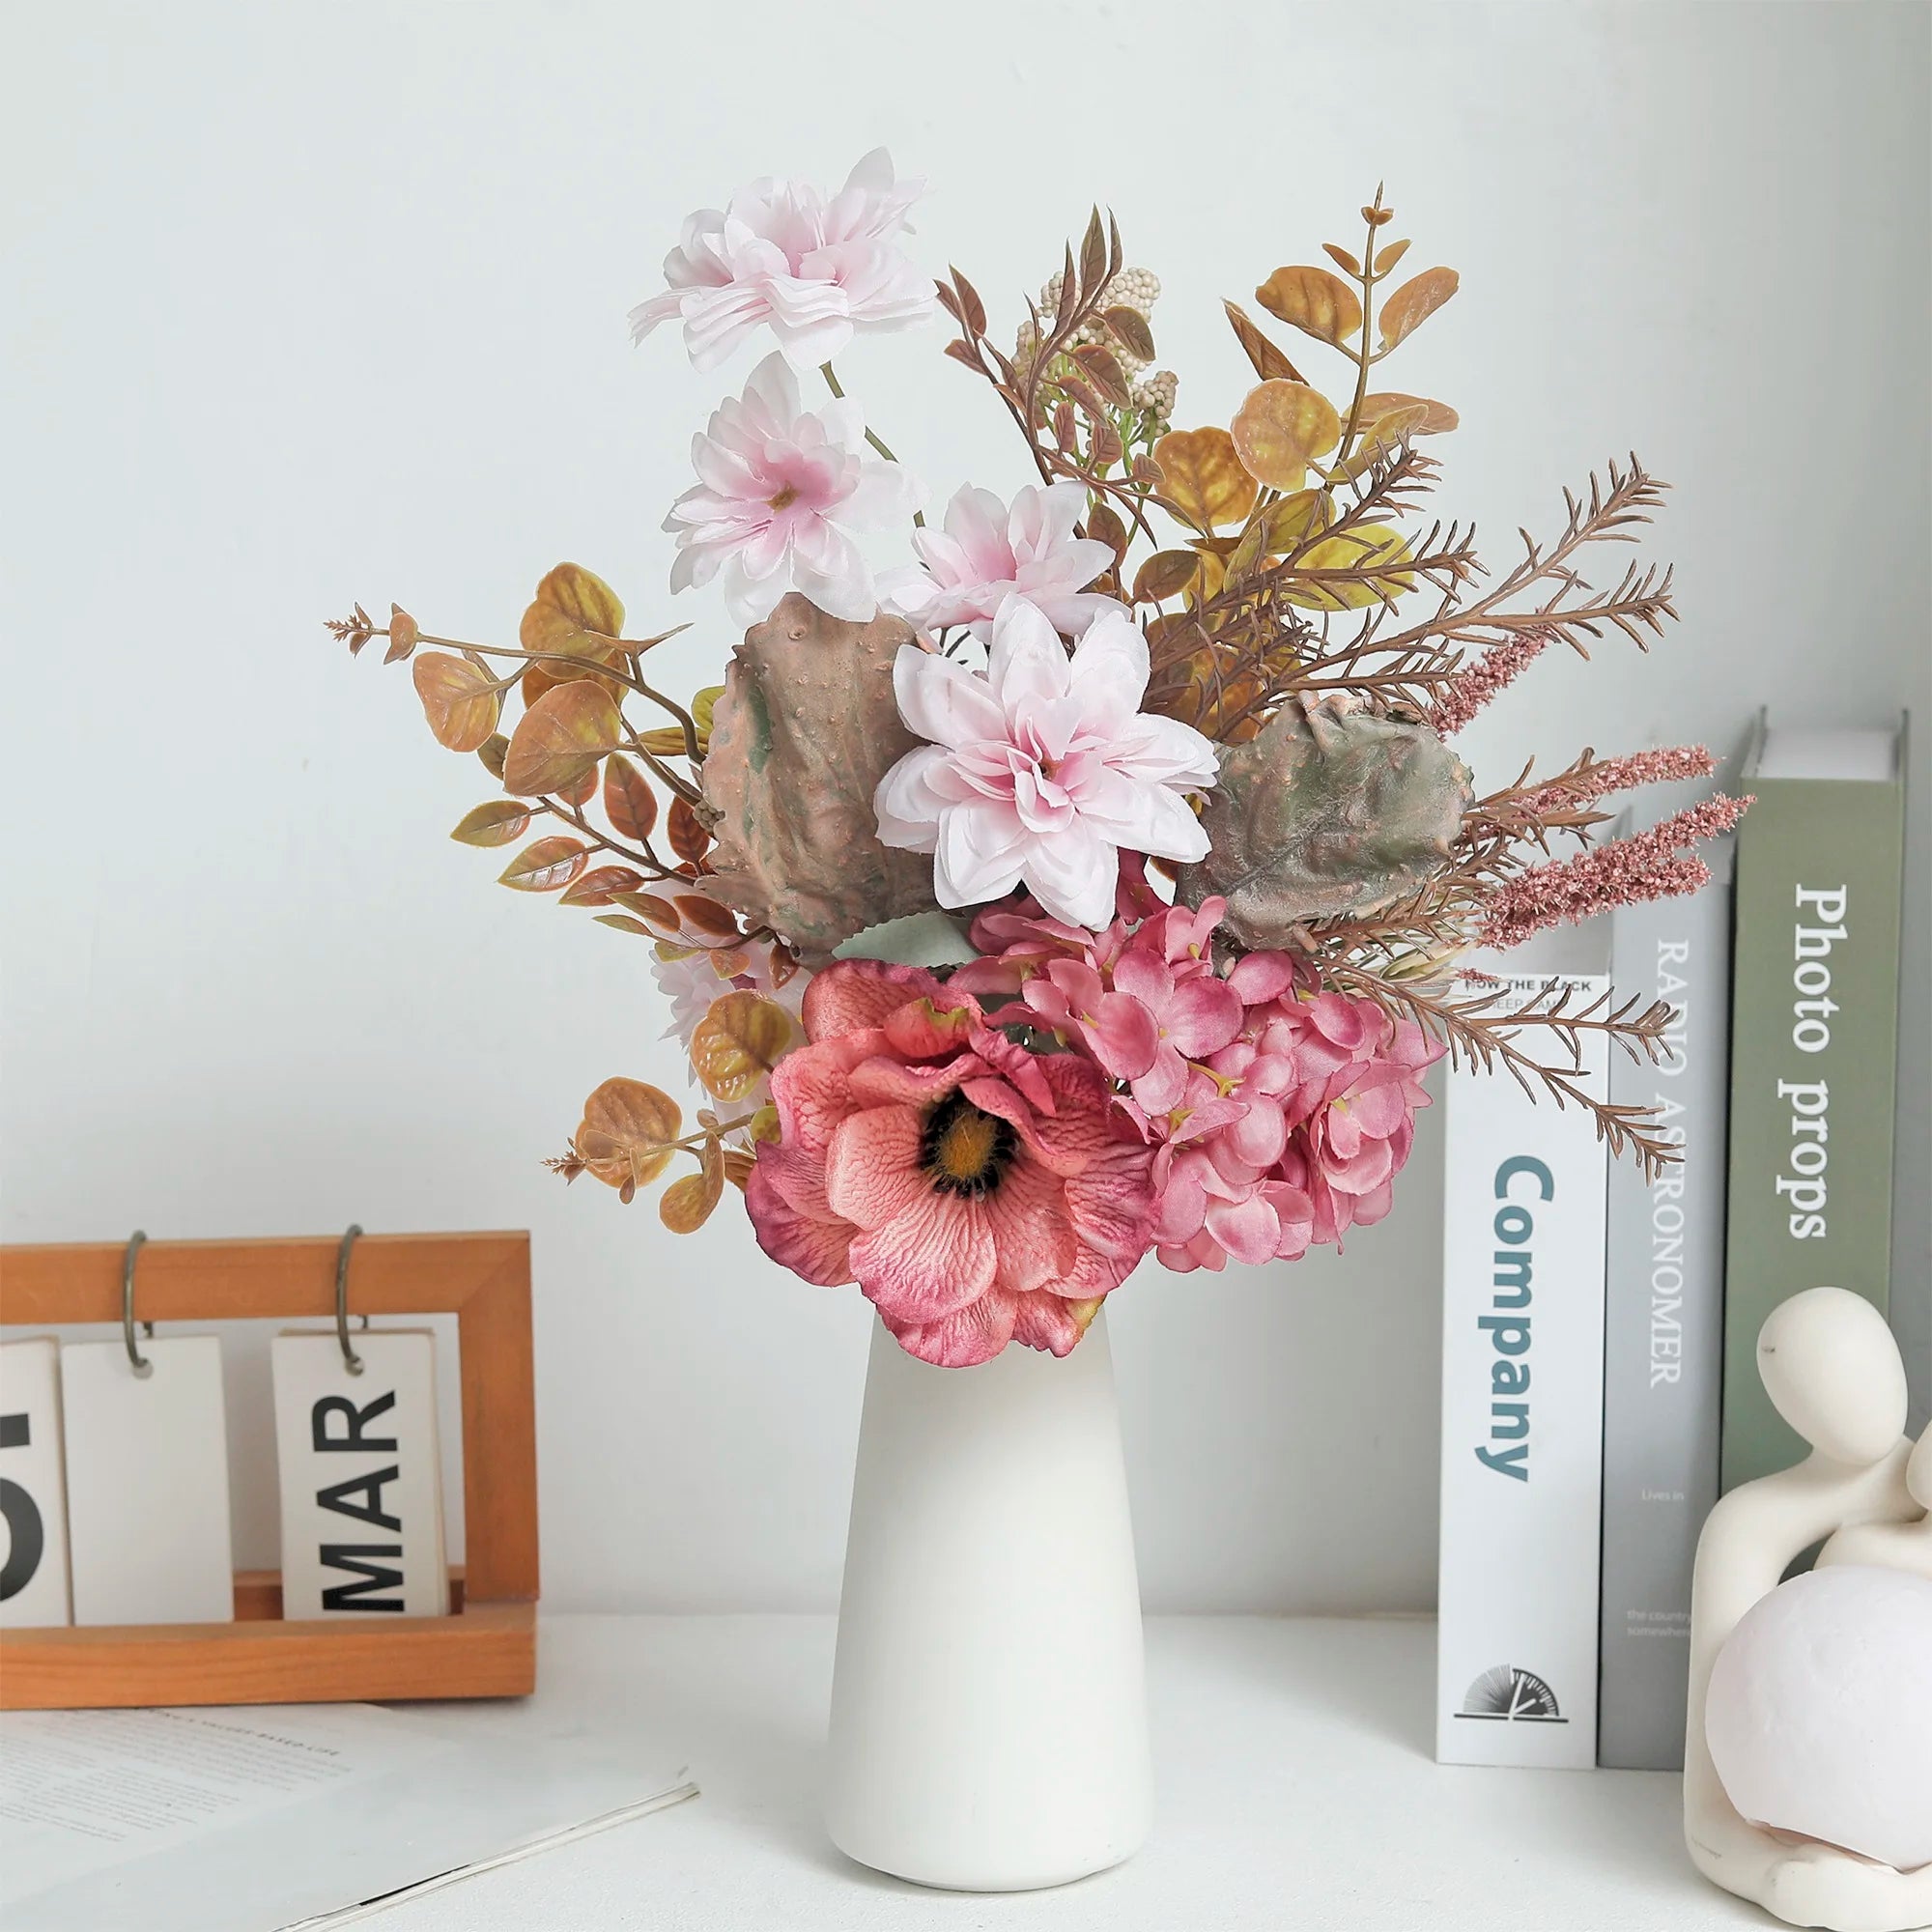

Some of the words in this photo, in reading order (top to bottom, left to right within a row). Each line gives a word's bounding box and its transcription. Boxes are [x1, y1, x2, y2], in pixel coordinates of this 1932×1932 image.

[1507, 980, 1535, 990] THE
[1793, 884, 1847, 1054] Photo
[1776, 1078, 1830, 1239] props
[1474, 1155, 1555, 1483] Company
[311, 1389, 405, 1612] MAR
